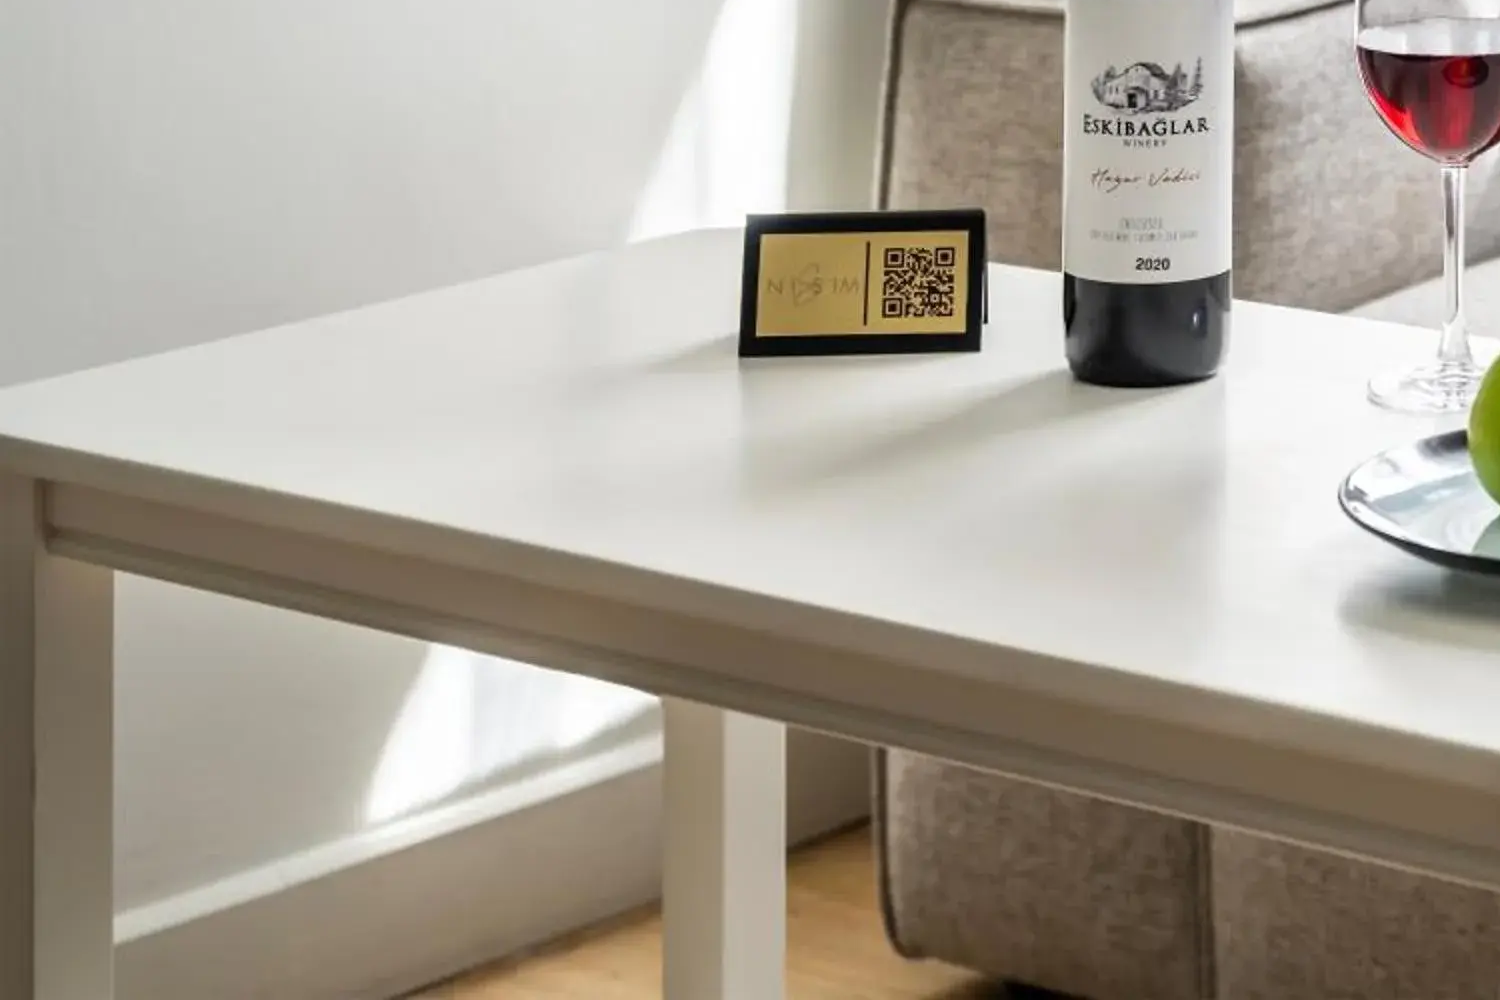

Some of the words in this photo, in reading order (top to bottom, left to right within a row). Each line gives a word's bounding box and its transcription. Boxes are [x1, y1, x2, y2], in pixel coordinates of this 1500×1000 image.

[1083, 114, 1210, 137] ESKİBAĞLAR
[1123, 138, 1168, 149] WINERY
[1135, 257, 1171, 271] 2020
